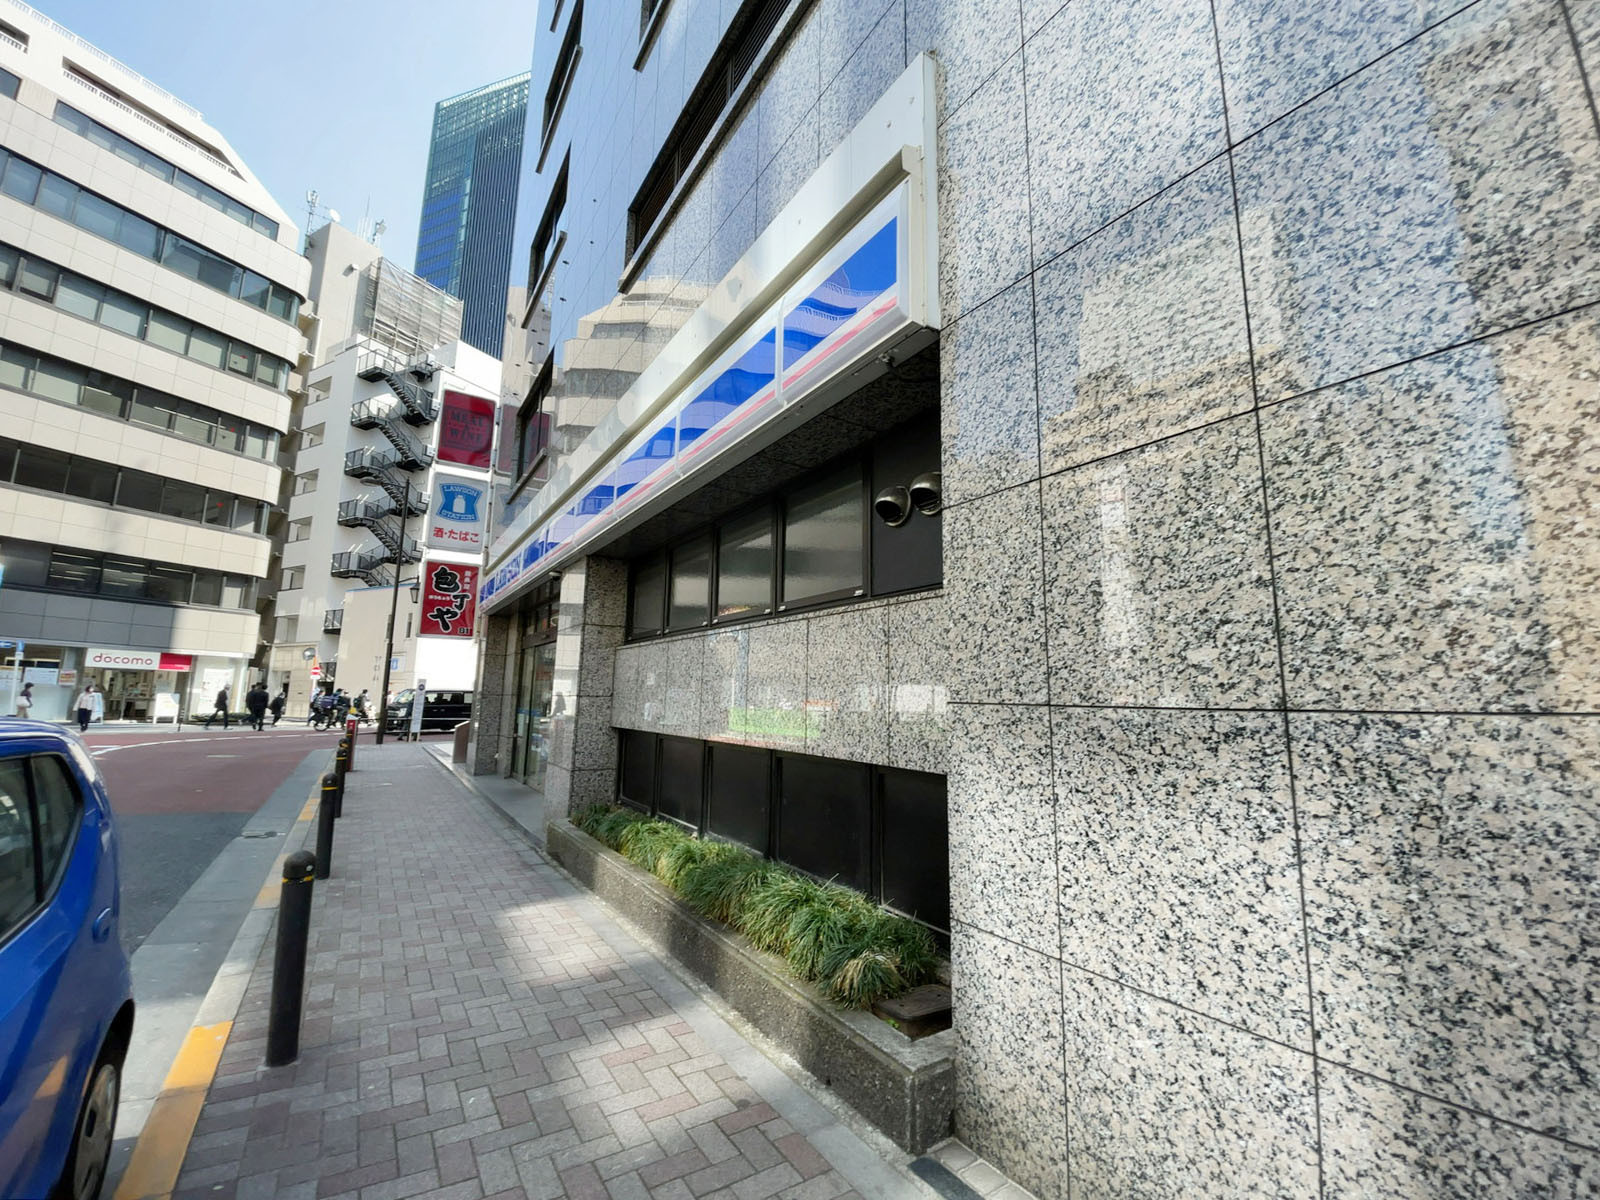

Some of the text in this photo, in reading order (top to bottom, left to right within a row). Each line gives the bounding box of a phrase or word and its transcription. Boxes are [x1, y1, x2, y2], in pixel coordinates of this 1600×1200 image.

[443, 485, 479, 496] LAWSON
[441, 509, 476, 520] STATION
[433, 526, 479, 543] 酒・たばこ
[93, 653, 153, 665] docomo
